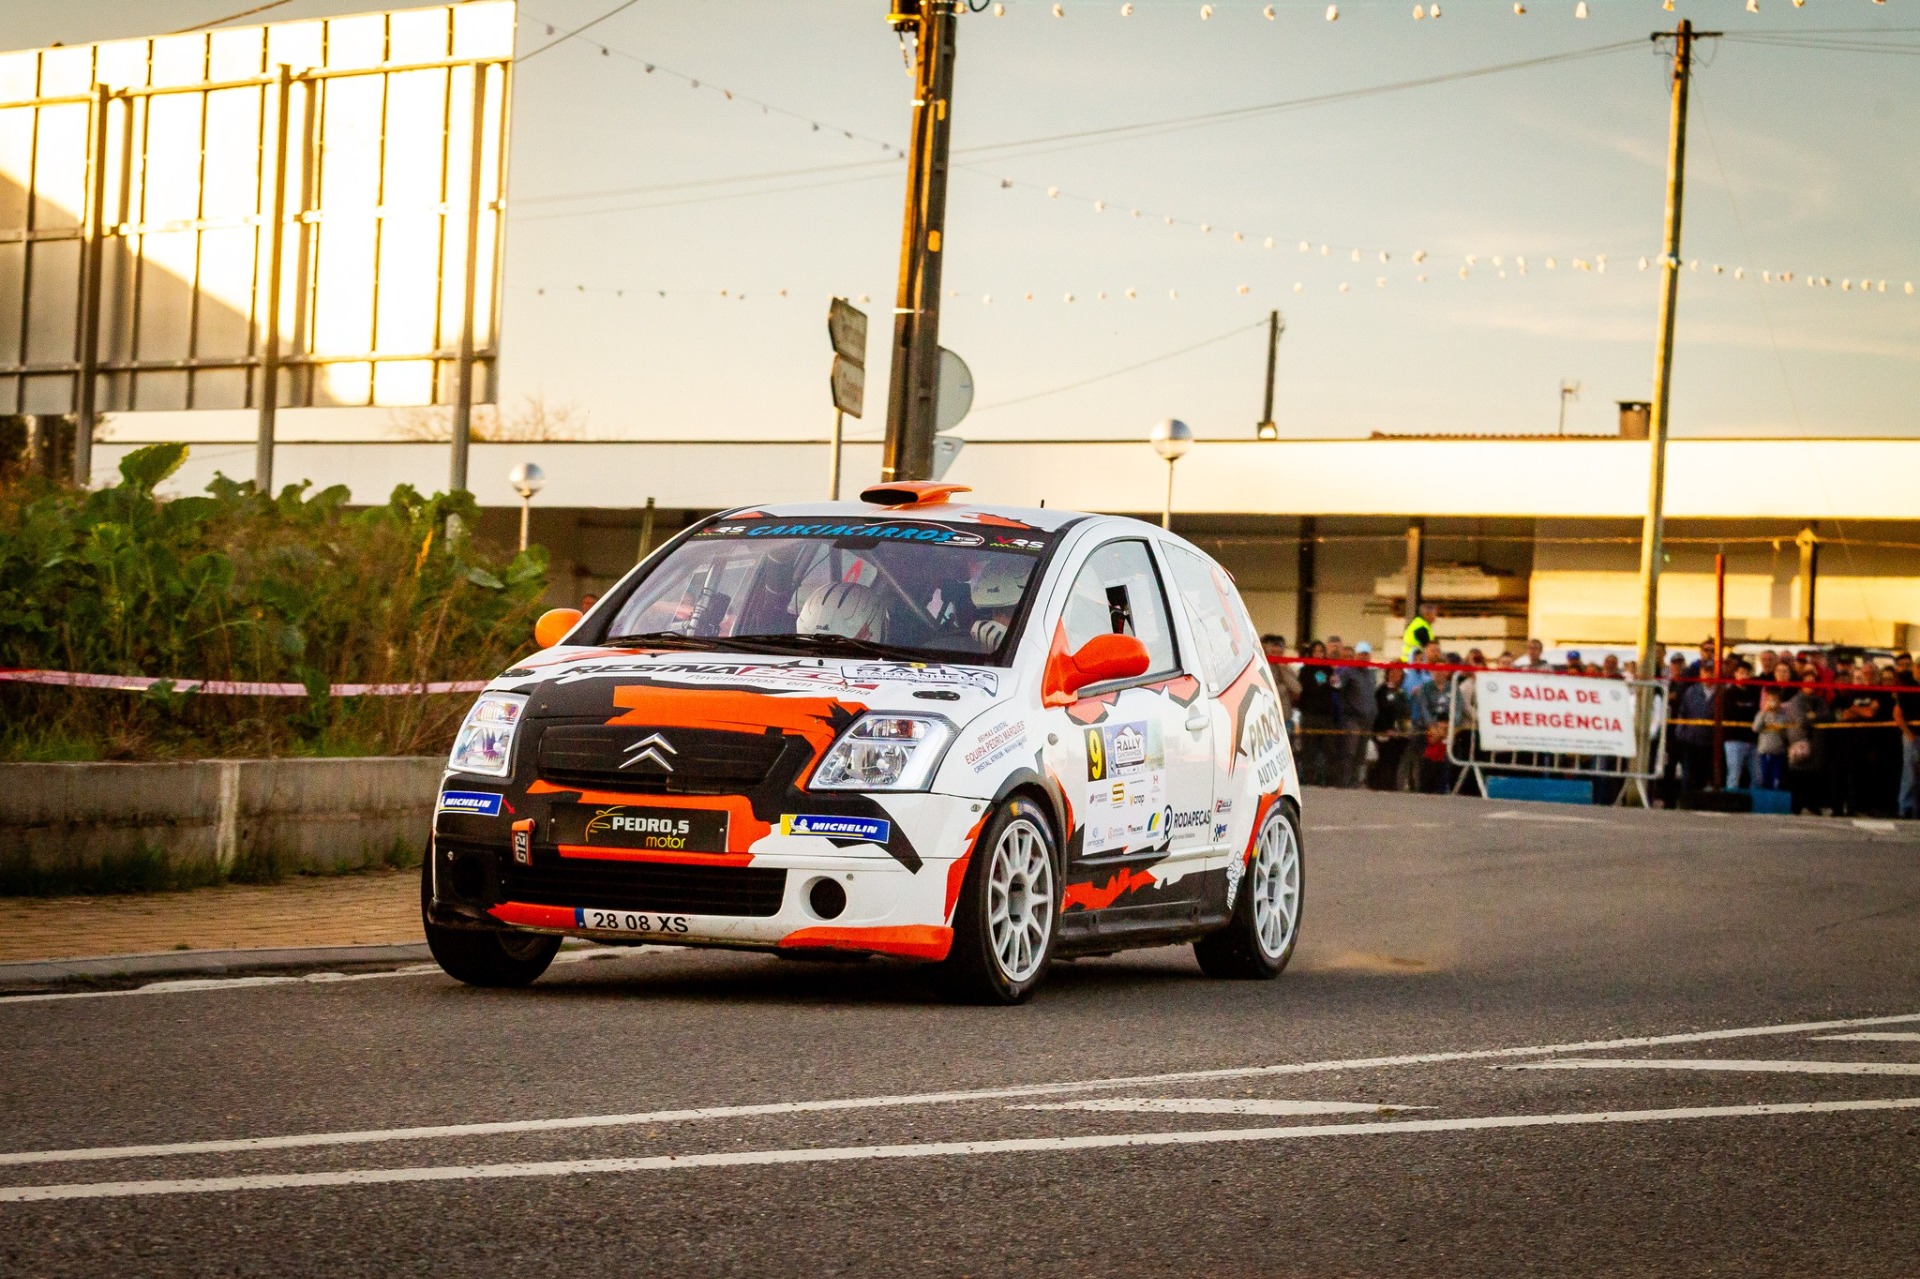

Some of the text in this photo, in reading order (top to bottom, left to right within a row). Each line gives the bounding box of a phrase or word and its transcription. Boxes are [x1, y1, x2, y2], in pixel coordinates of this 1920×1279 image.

[747, 523, 957, 543] GARCIACARROS
[786, 680, 812, 688] em
[820, 685, 870, 696] resina
[1510, 684, 1601, 704] SAÍDA DE
[1490, 709, 1622, 732] EMERGÊNCIA
[1089, 729, 1103, 780] 9
[1116, 738, 1141, 752] RALLY
[1257, 759, 1278, 787] AUTO
[445, 797, 492, 808] MICHELIN
[612, 816, 690, 836] PEDRO,S
[811, 822, 878, 834] MICHELIN
[645, 834, 687, 849] motor
[593, 912, 689, 933] 28 08 XS
